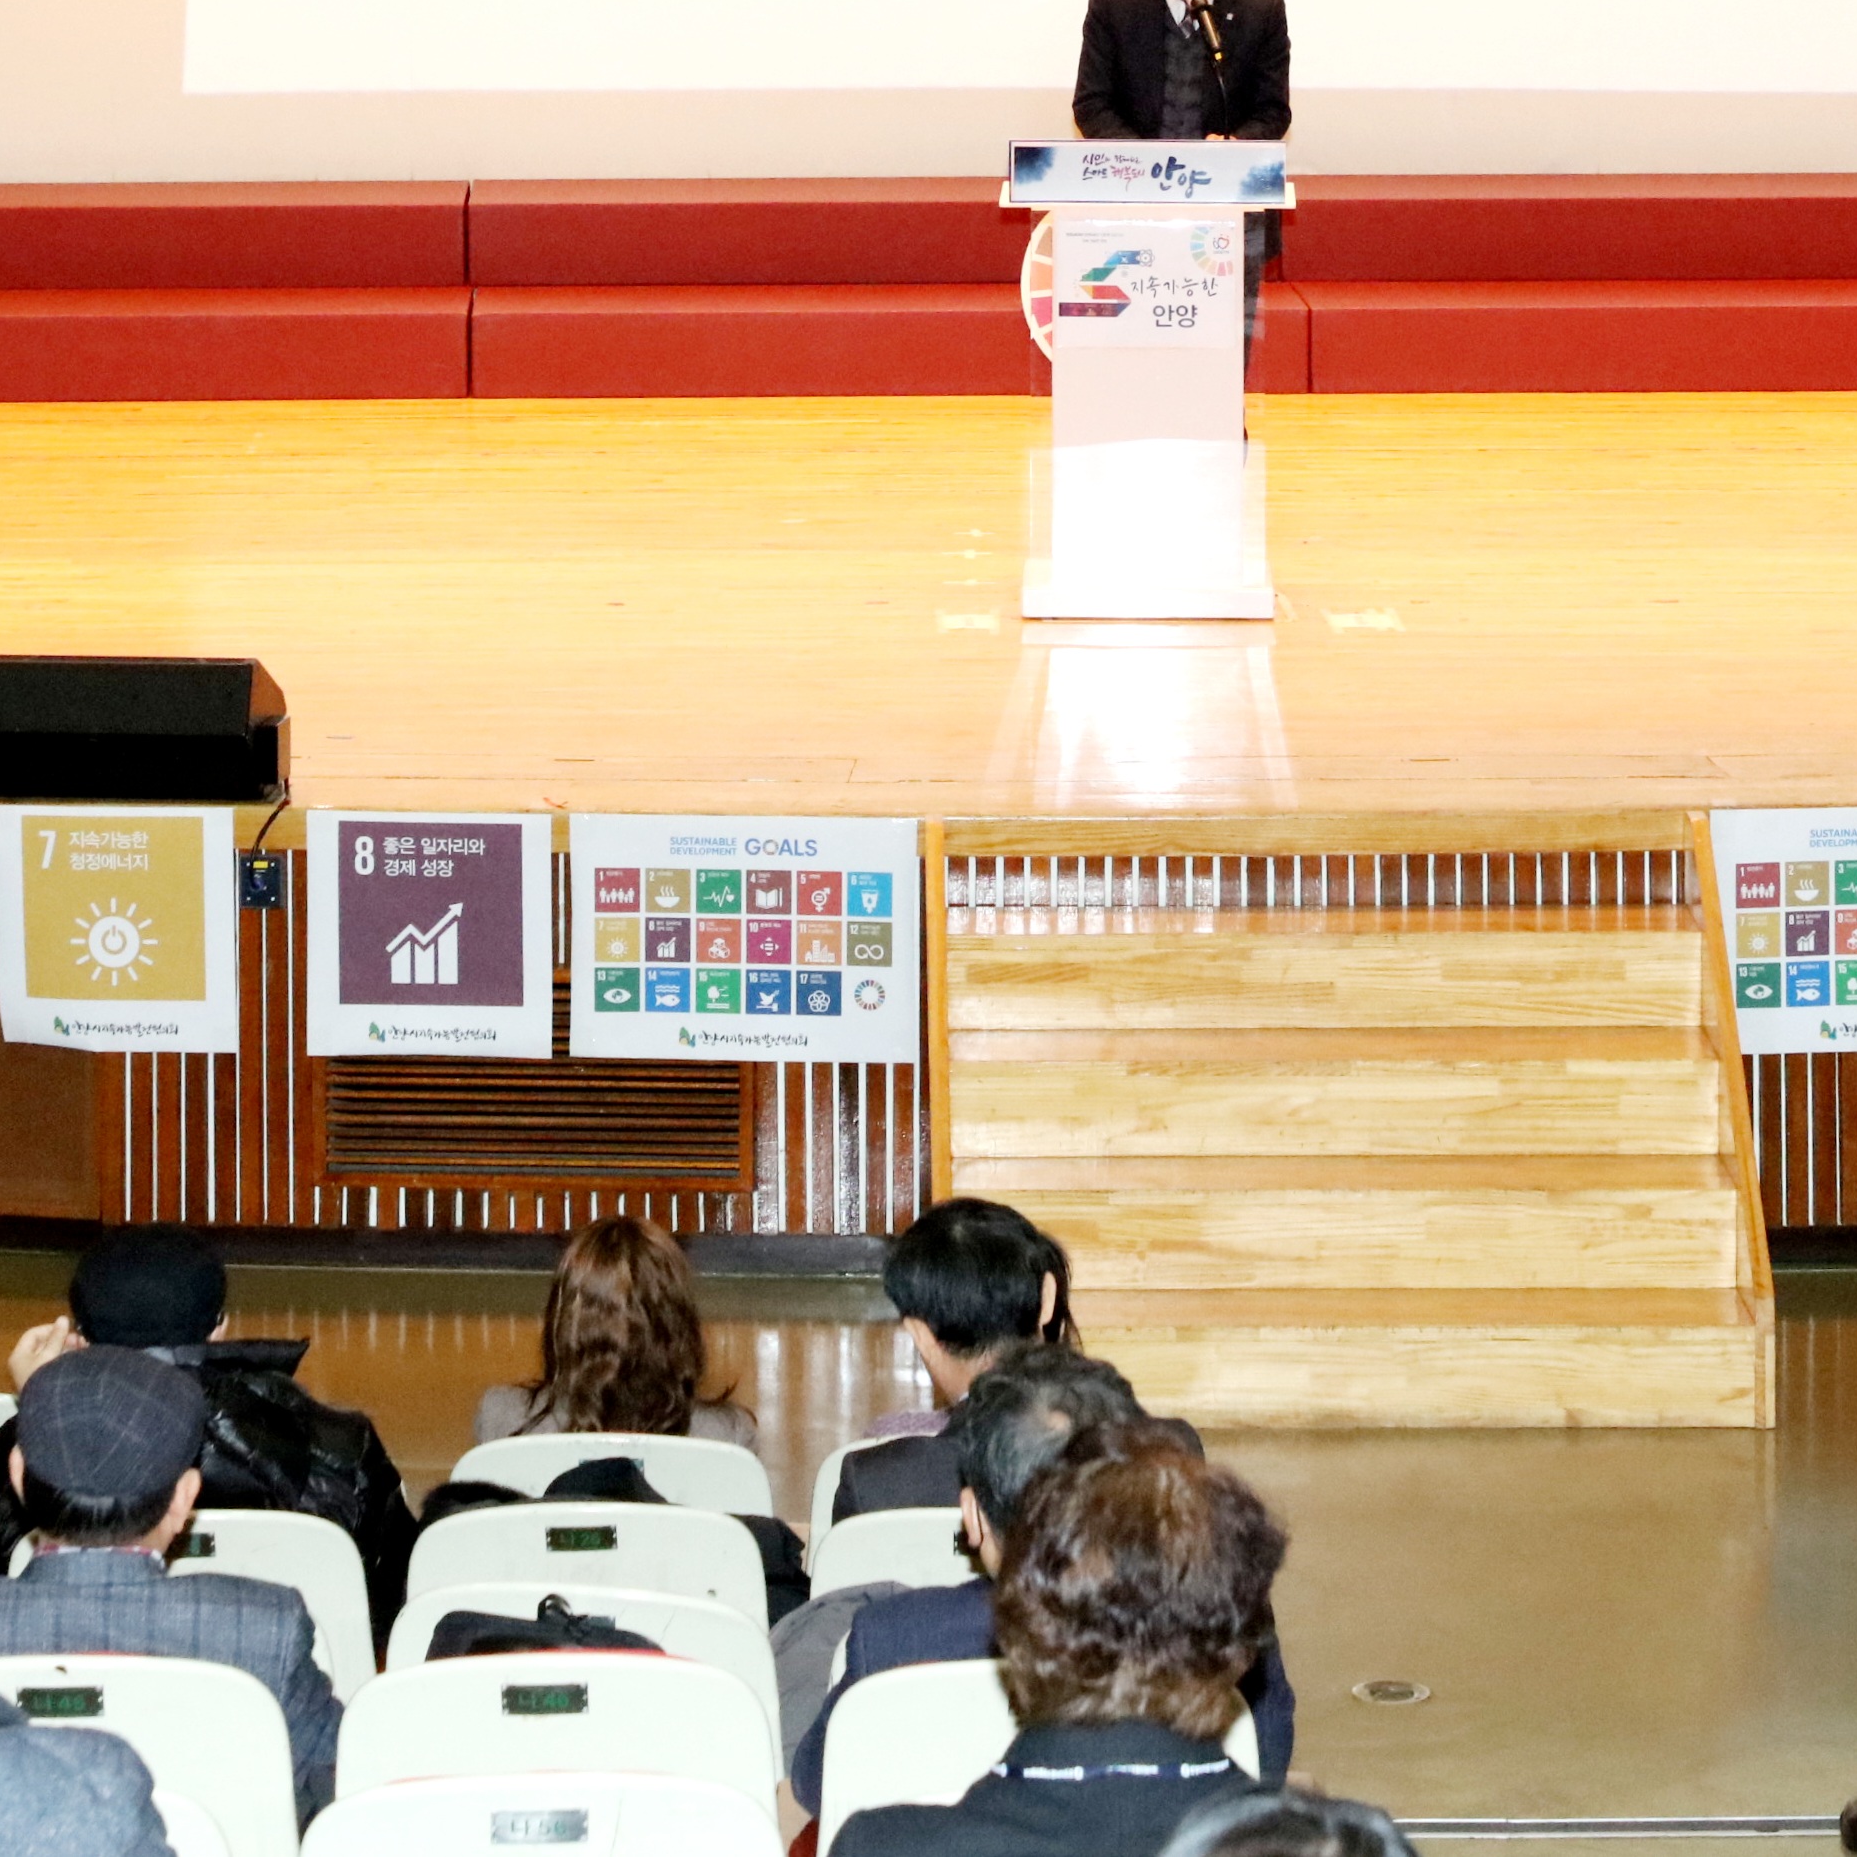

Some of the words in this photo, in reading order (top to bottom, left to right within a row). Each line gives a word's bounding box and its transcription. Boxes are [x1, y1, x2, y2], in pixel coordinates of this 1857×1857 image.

[1150, 156, 1212, 199] 안양
[1131, 275, 1219, 298] 지속가능한
[1152, 304, 1198, 328] 안양
[69, 830, 149, 850] 지속가능한
[670, 837, 737, 846] SUSTAINABLE
[37, 830, 56, 869] 7
[383, 836, 415, 856] 좋은
[420, 836, 486, 857] 일자리와
[670, 847, 736, 855] DEVELOPMENT
[744, 839, 818, 856] GOALS
[69, 852, 149, 871] 청정에너지
[354, 836, 374, 877] 8
[383, 858, 417, 878] 경제
[421, 858, 453, 878] 성장
[649, 871, 654, 881] 2
[700, 872, 705, 882] 3
[750, 873, 756, 883] 4
[750, 923, 758, 932] 10
[850, 924, 858, 934] 12
[597, 970, 606, 980] 13
[648, 971, 656, 980] 14
[1739, 967, 1748, 977] 13
[749, 973, 758, 982] 16
[800, 973, 808, 983] 17
